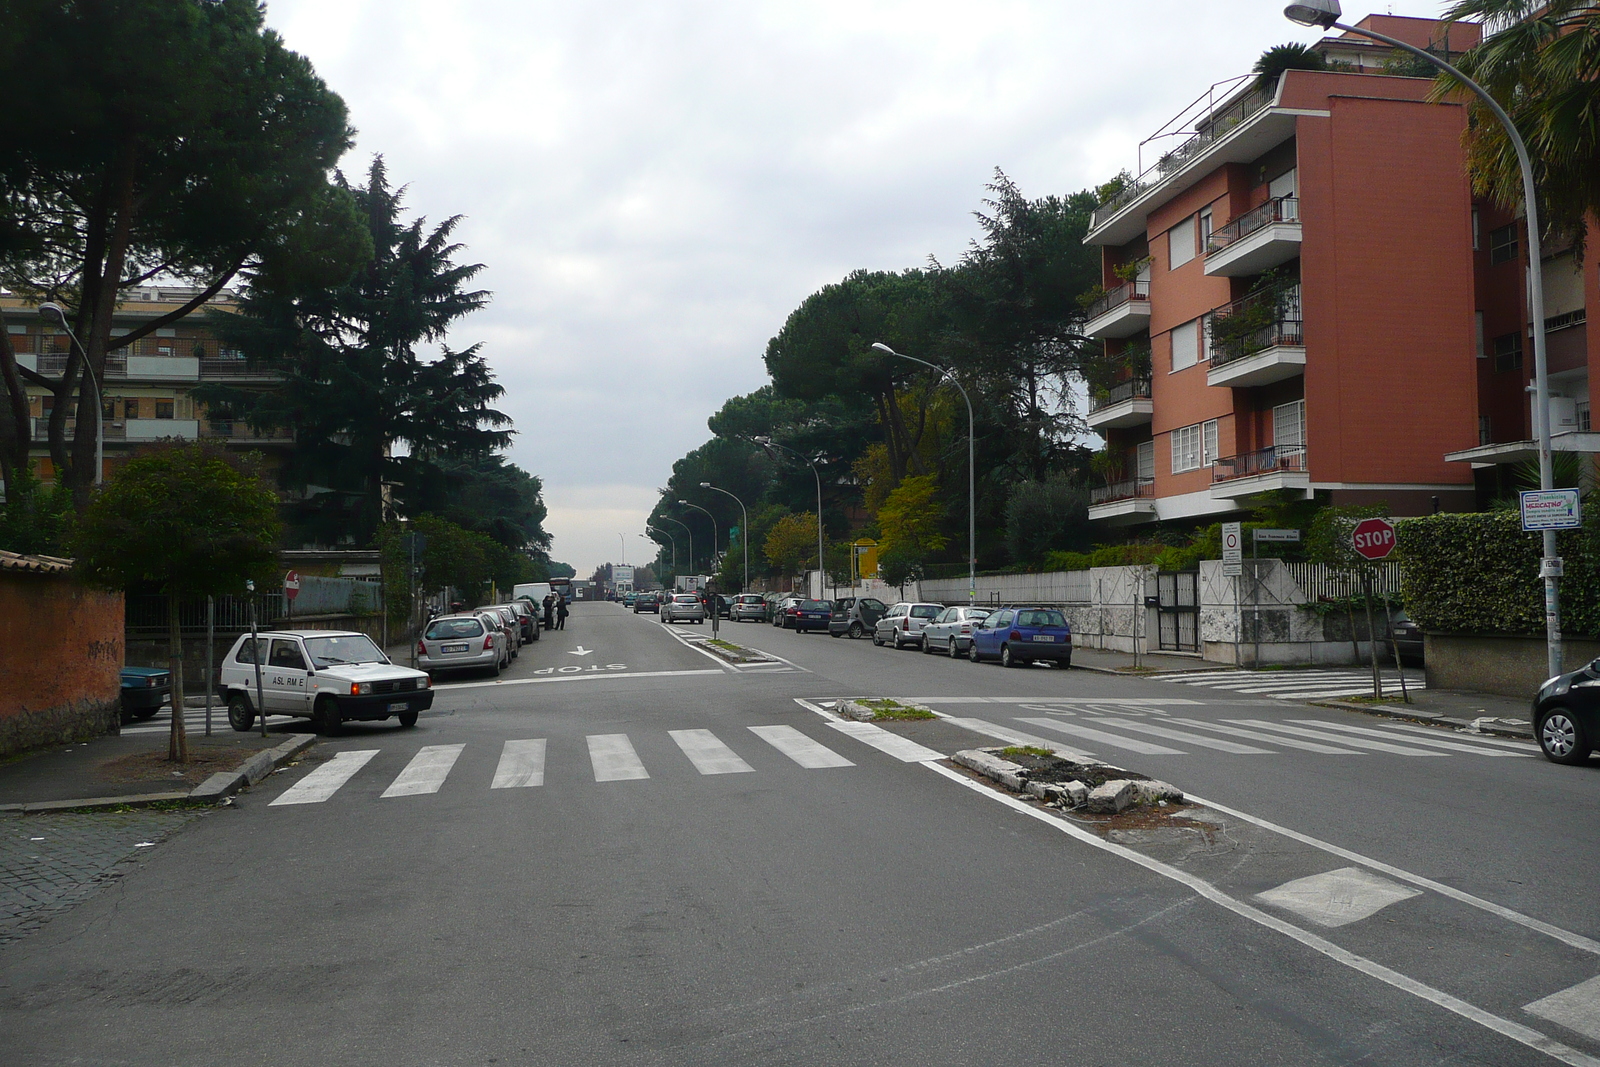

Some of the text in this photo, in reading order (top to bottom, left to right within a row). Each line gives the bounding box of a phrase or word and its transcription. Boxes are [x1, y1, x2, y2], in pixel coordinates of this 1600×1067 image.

[1525, 500, 1562, 508] MERCATINO
[1355, 530, 1392, 548] STOP
[533, 663, 628, 675] STOP
[272, 676, 304, 687] ASL RM E
